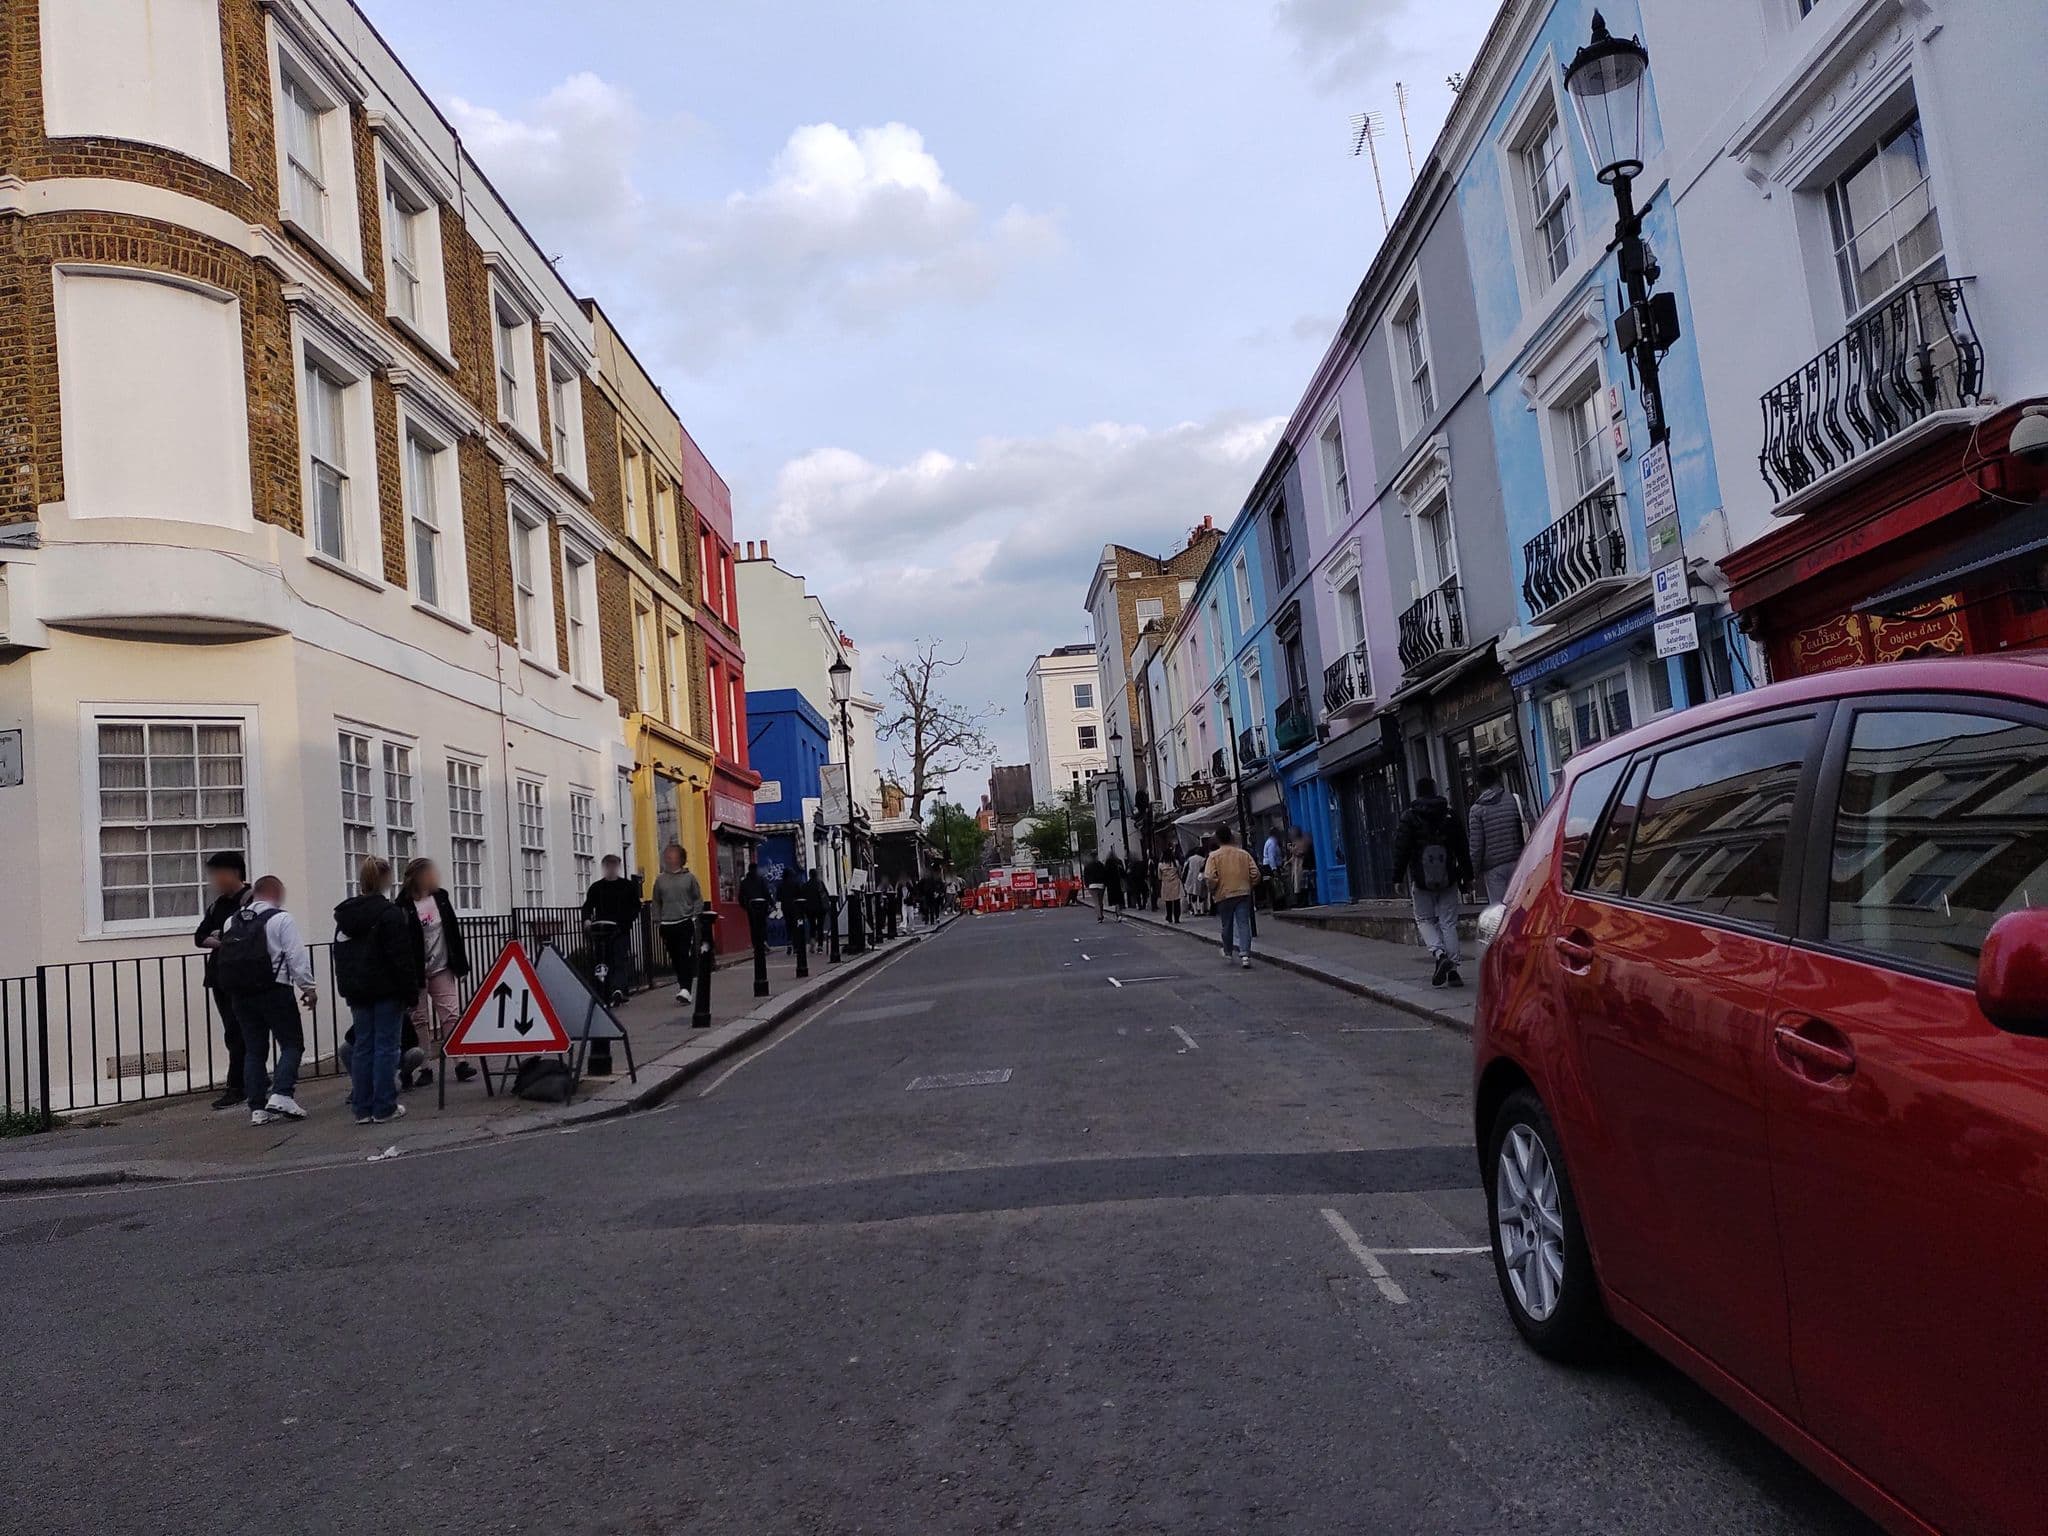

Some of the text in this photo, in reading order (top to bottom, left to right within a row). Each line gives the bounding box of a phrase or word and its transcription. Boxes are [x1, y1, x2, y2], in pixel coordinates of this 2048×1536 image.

[1666, 564, 1678, 573] Permit
[1663, 592, 1678, 602] Saturday
[1658, 616, 1691, 630] Antique traders
[1670, 627, 1679, 635] only
[1890, 622, 1942, 646] Objets d'Art
[1667, 635, 1687, 645] Saturday
[1806, 631, 1842, 650] GALLERY
[1821, 653, 1853, 669] Antiques
[1181, 790, 1208, 800] ZABI
